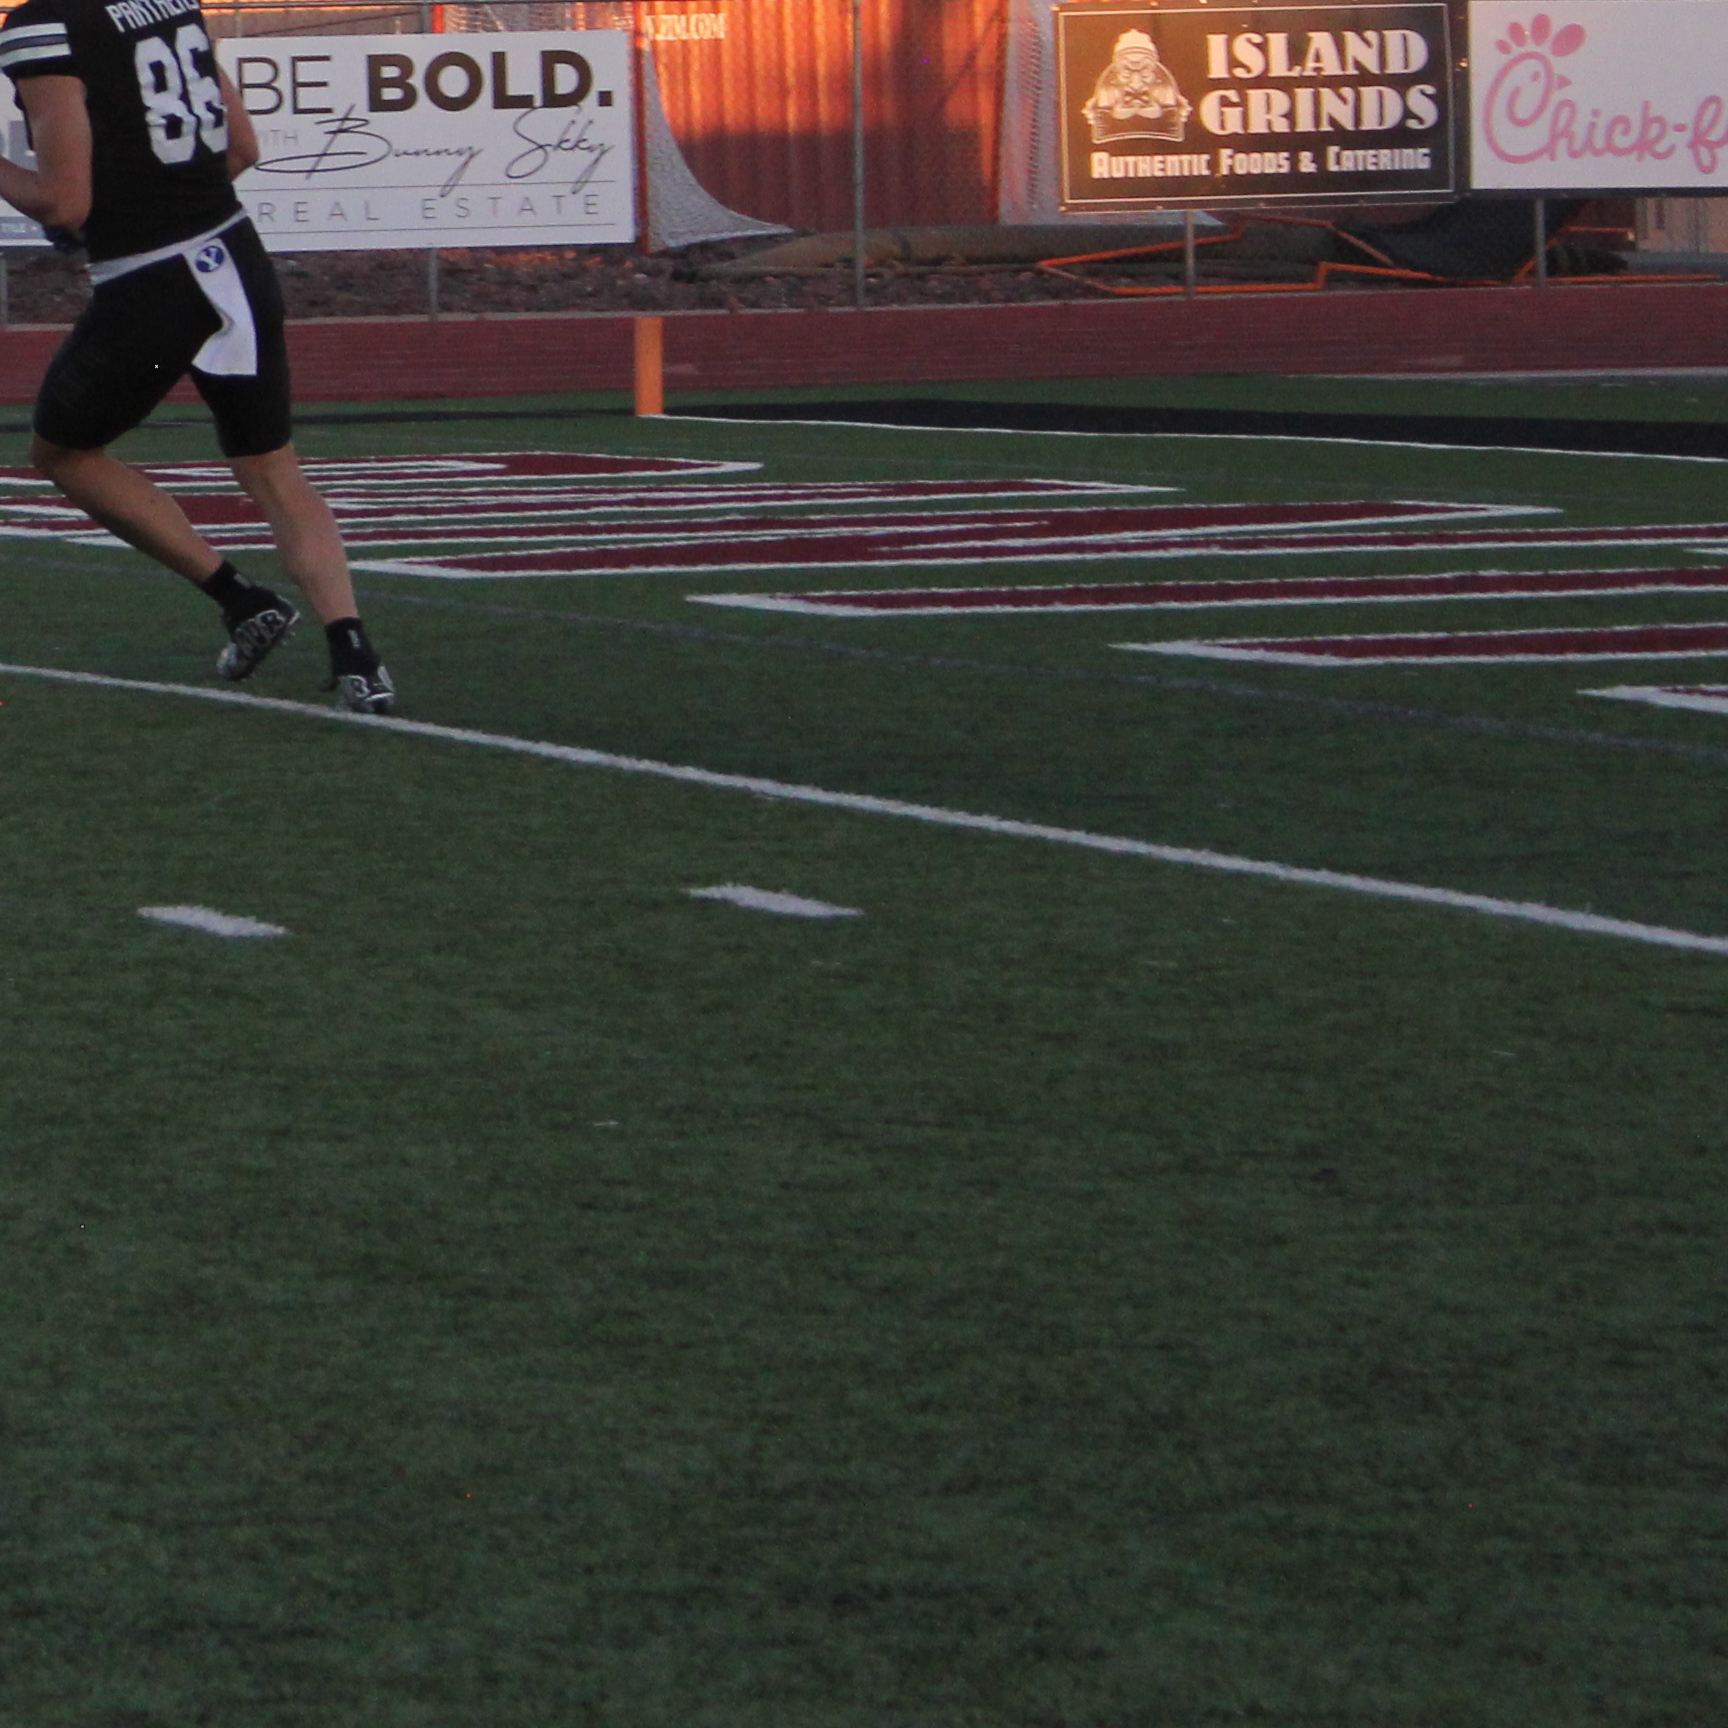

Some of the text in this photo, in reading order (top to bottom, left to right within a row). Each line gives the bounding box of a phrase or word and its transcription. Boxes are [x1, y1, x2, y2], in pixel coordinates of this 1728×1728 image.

[1205, 29, 1429, 79] ISLAND
[134, 23, 230, 165] 86
[236, 49, 614, 115] BE BOLD.
[1199, 85, 1439, 135] GRINDS
[1482, 49, 1728, 174] Chick-f
[1298, 151, 1318, 173] &
[258, 194, 601, 224] REAL ESTATE
